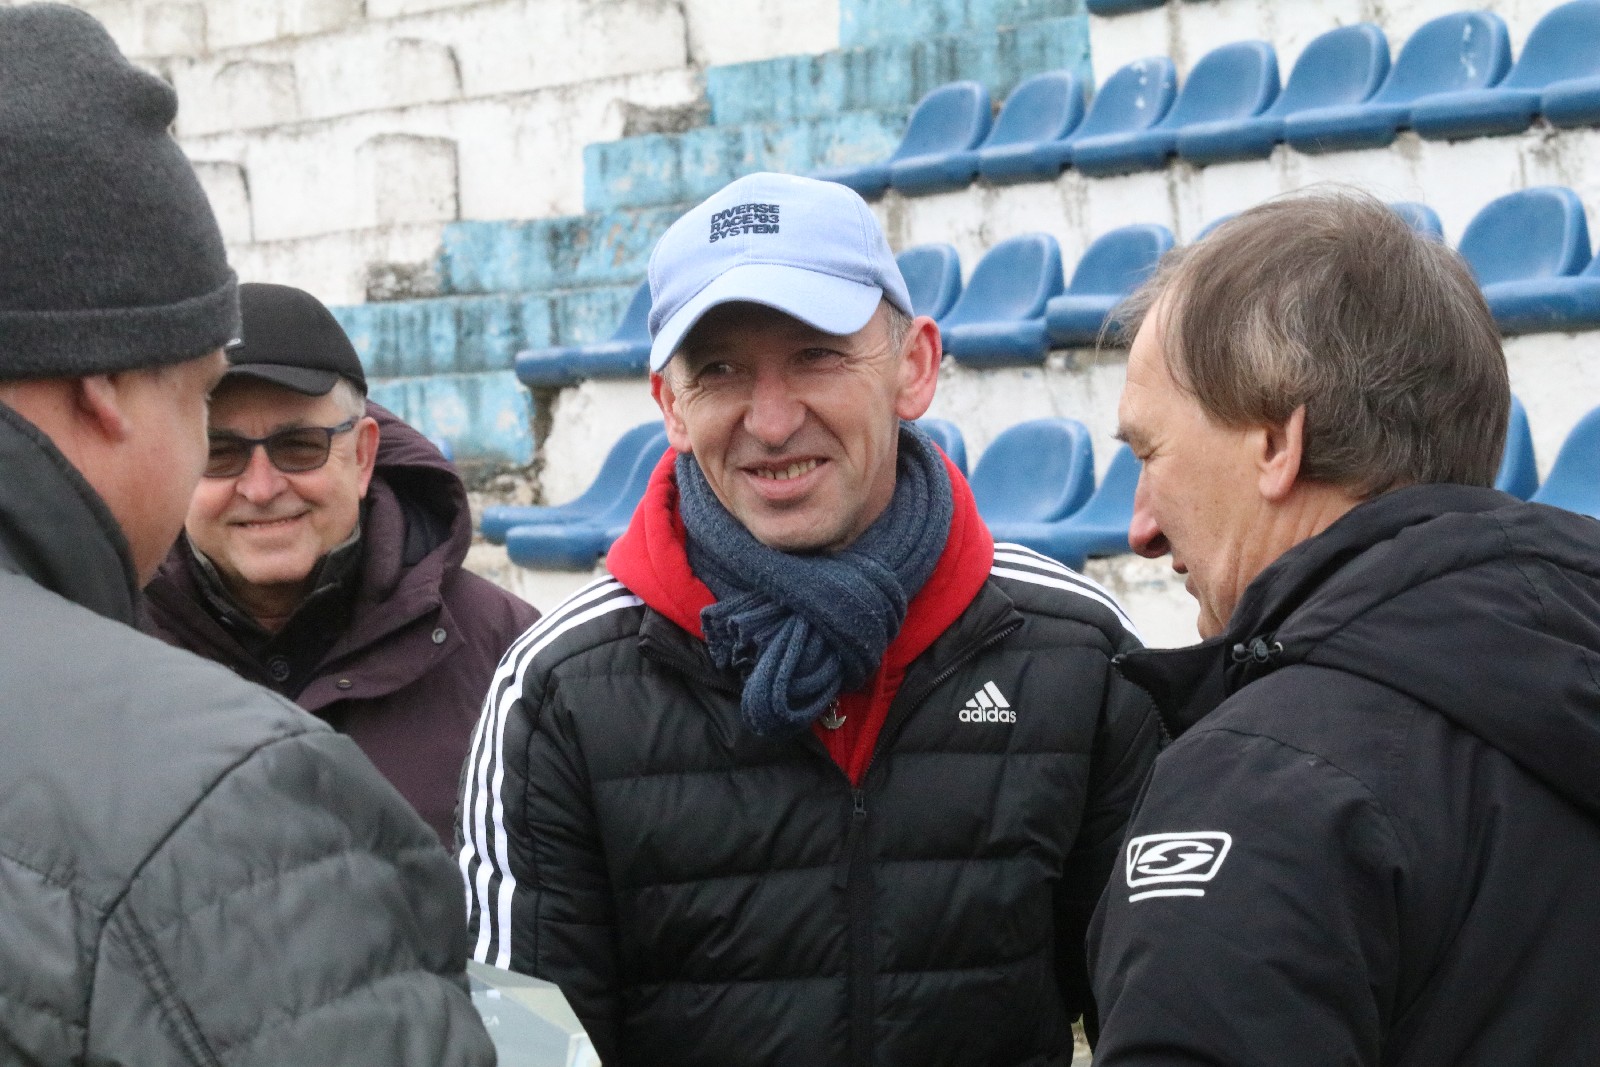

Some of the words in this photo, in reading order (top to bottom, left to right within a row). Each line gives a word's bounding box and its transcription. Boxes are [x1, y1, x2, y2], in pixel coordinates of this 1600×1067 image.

[711, 204, 779, 224] DIVERSE
[709, 225, 779, 243] SYSTEM
[959, 706, 1017, 723] adidas
